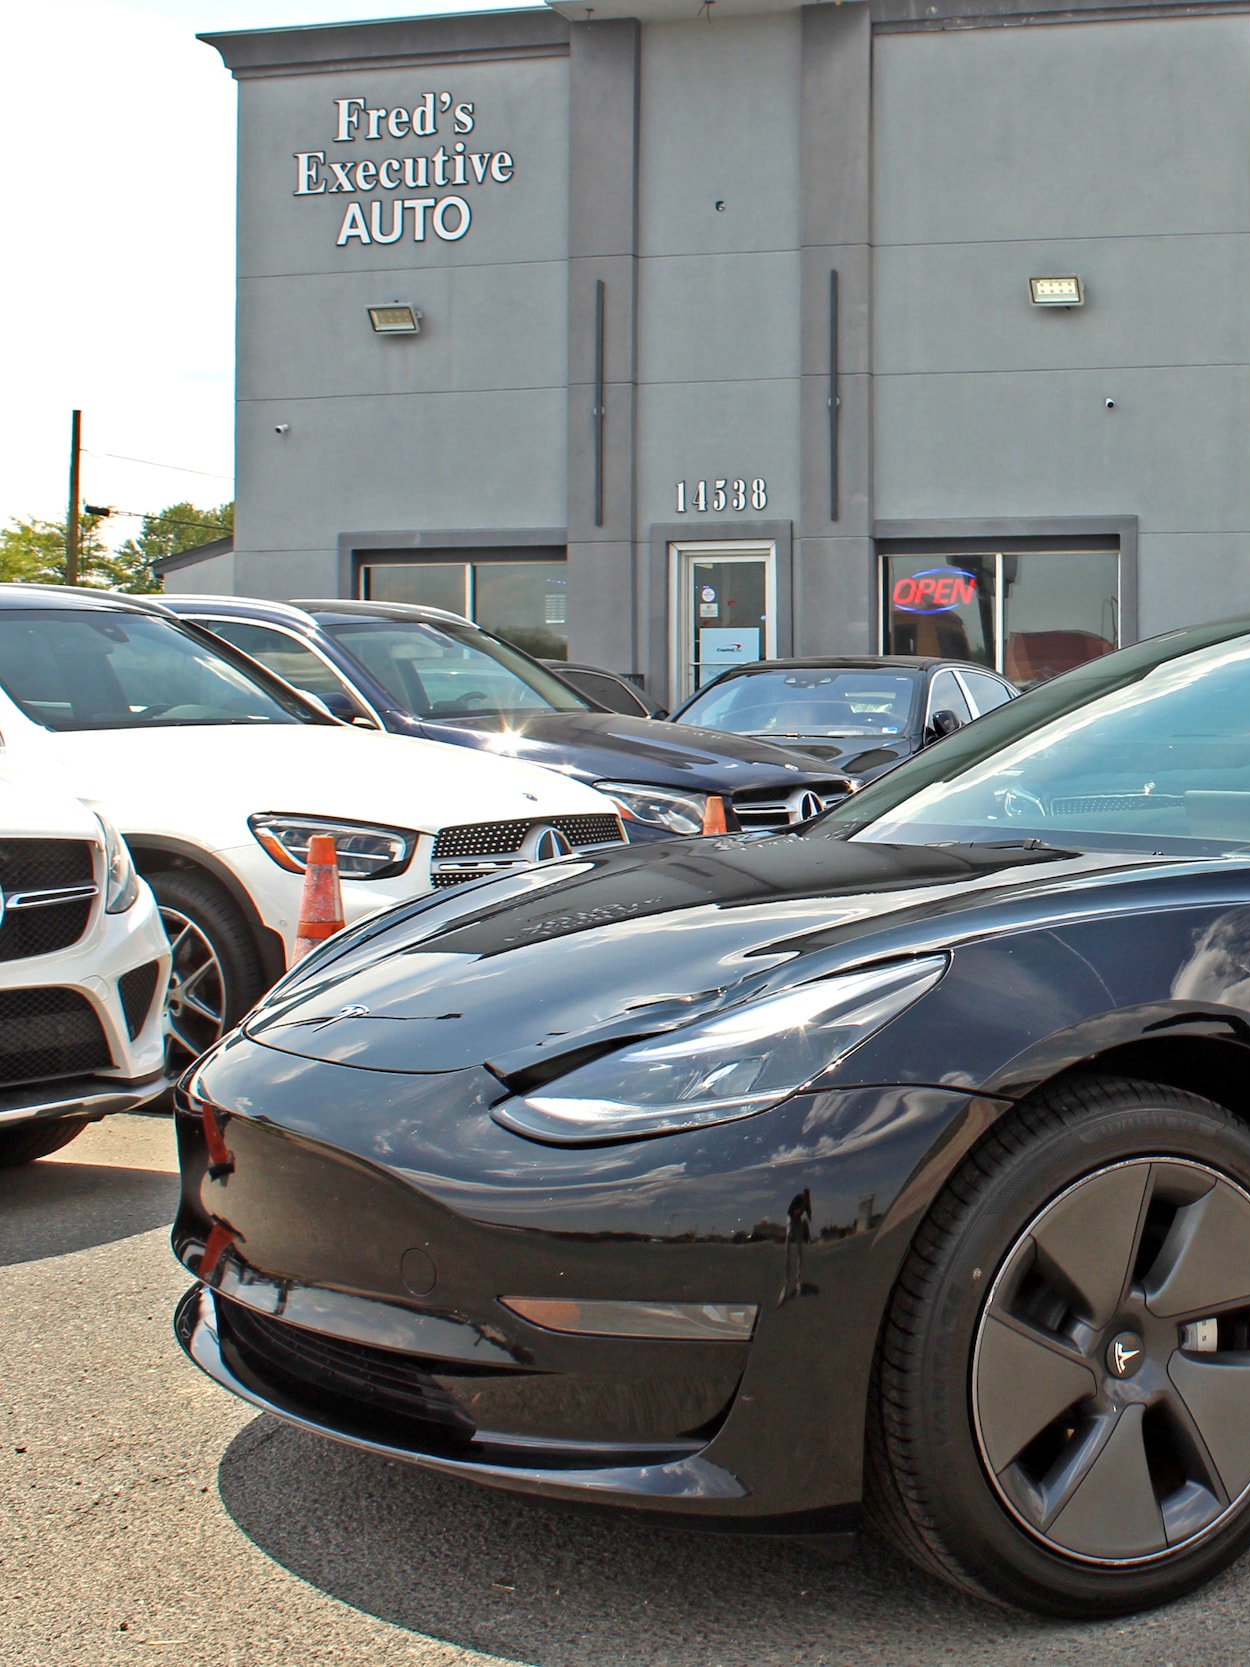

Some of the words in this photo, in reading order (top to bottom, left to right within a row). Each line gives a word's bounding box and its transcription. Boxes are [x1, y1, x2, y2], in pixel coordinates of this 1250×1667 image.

[333, 92, 475, 142] Fred's
[293, 142, 515, 196] Executive
[336, 196, 472, 247] AUTO
[675, 477, 768, 513] 14538
[893, 578, 976, 604] OPEN
